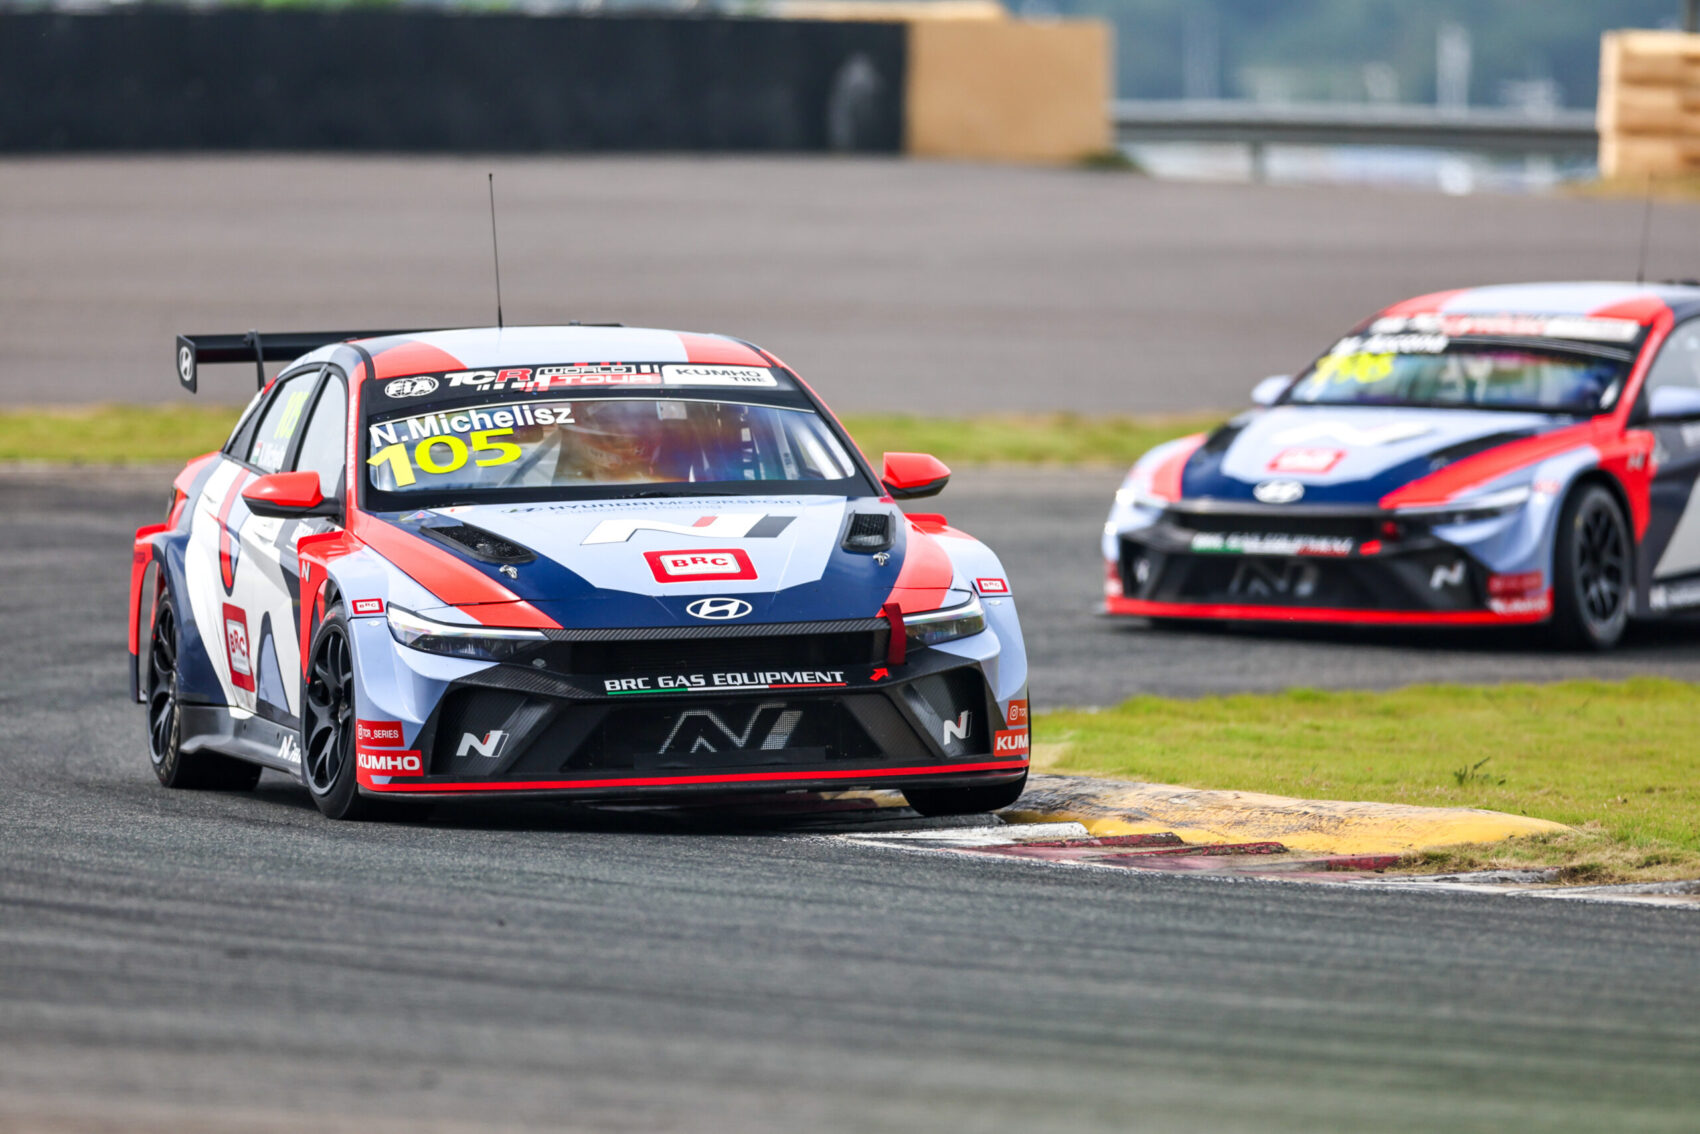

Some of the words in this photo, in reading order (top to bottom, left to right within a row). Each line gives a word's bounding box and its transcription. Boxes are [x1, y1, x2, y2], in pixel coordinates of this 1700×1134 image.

[444, 368, 533, 387] TCR
[544, 366, 629, 375] WORLD
[558, 374, 651, 384] TOUR
[675, 368, 760, 378] KUMHO
[387, 378, 432, 396] FIA
[368, 405, 575, 447] N.Michelisz
[366, 427, 522, 487] 105
[671, 556, 729, 568] BRC
[229, 629, 246, 657] BRC
[603, 677, 652, 691] BRC
[657, 674, 706, 688] GAS
[712, 671, 844, 686] EQUIPMENT
[357, 752, 421, 770] KUMHO
